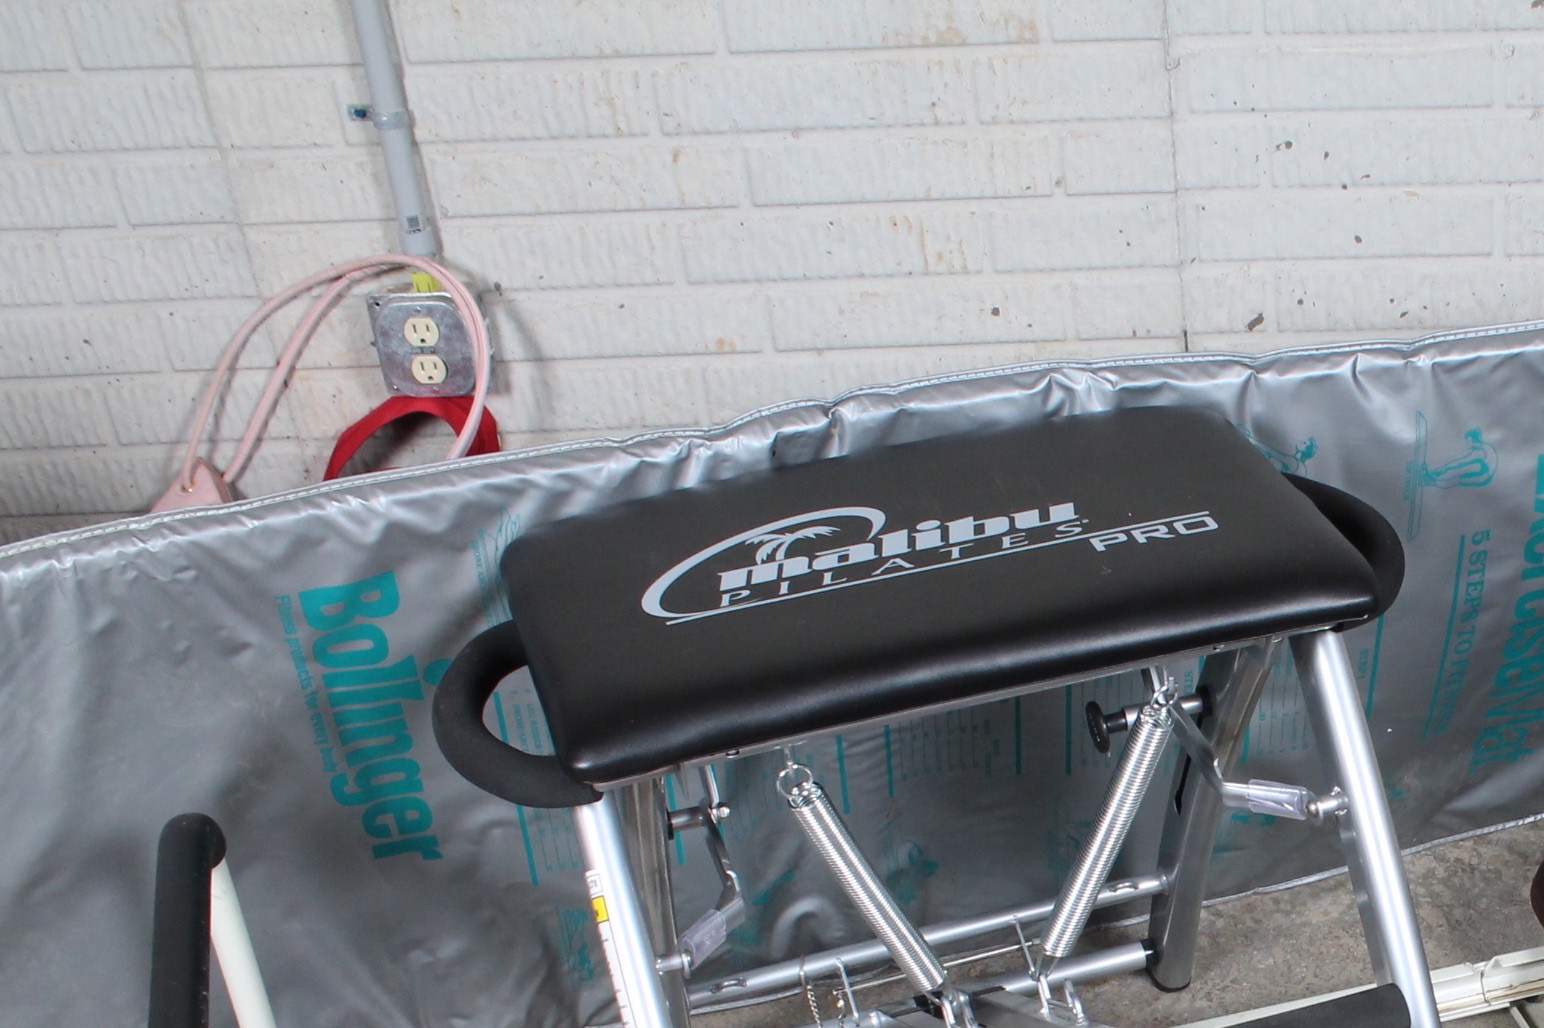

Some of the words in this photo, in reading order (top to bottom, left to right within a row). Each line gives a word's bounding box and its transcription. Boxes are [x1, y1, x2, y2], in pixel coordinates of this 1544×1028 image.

[718, 501, 1080, 592] malibu
[719, 520, 1085, 608] PILATES
[1087, 513, 1220, 552] PRO
[1471, 529, 1491, 546] 5
[1459, 548, 1489, 626] STEPS
[1453, 628, 1477, 656] TO
[298, 569, 451, 863] Bollinger
